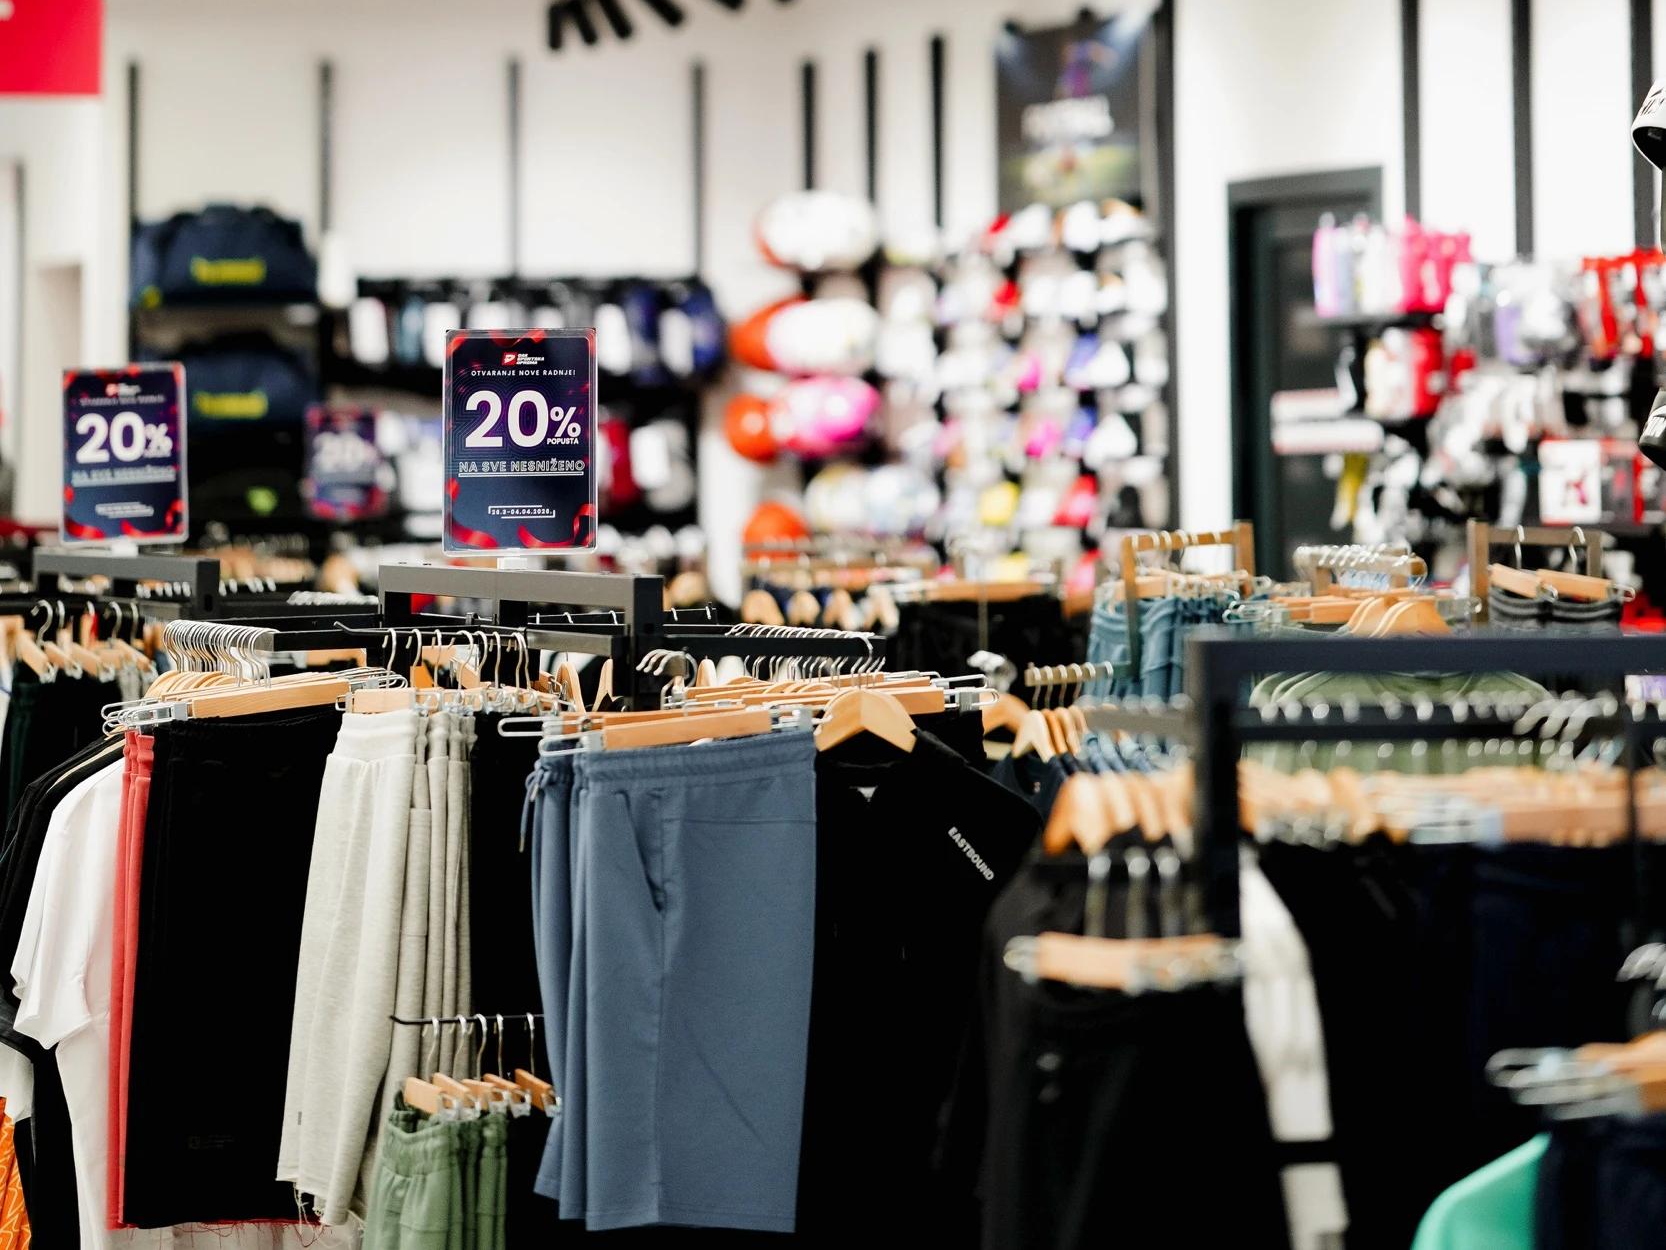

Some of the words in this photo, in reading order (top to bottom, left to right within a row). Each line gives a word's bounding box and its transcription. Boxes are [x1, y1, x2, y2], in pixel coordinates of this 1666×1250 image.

[471, 369, 516, 377] OTVARANJE
[465, 389, 582, 448] 20%
[546, 436, 579, 445] POPUSTA
[458, 461, 478, 473] NA
[481, 461, 507, 473] SVE
[510, 457, 586, 472] NESNIŽENO
[948, 826, 995, 881] EASTBOUND
